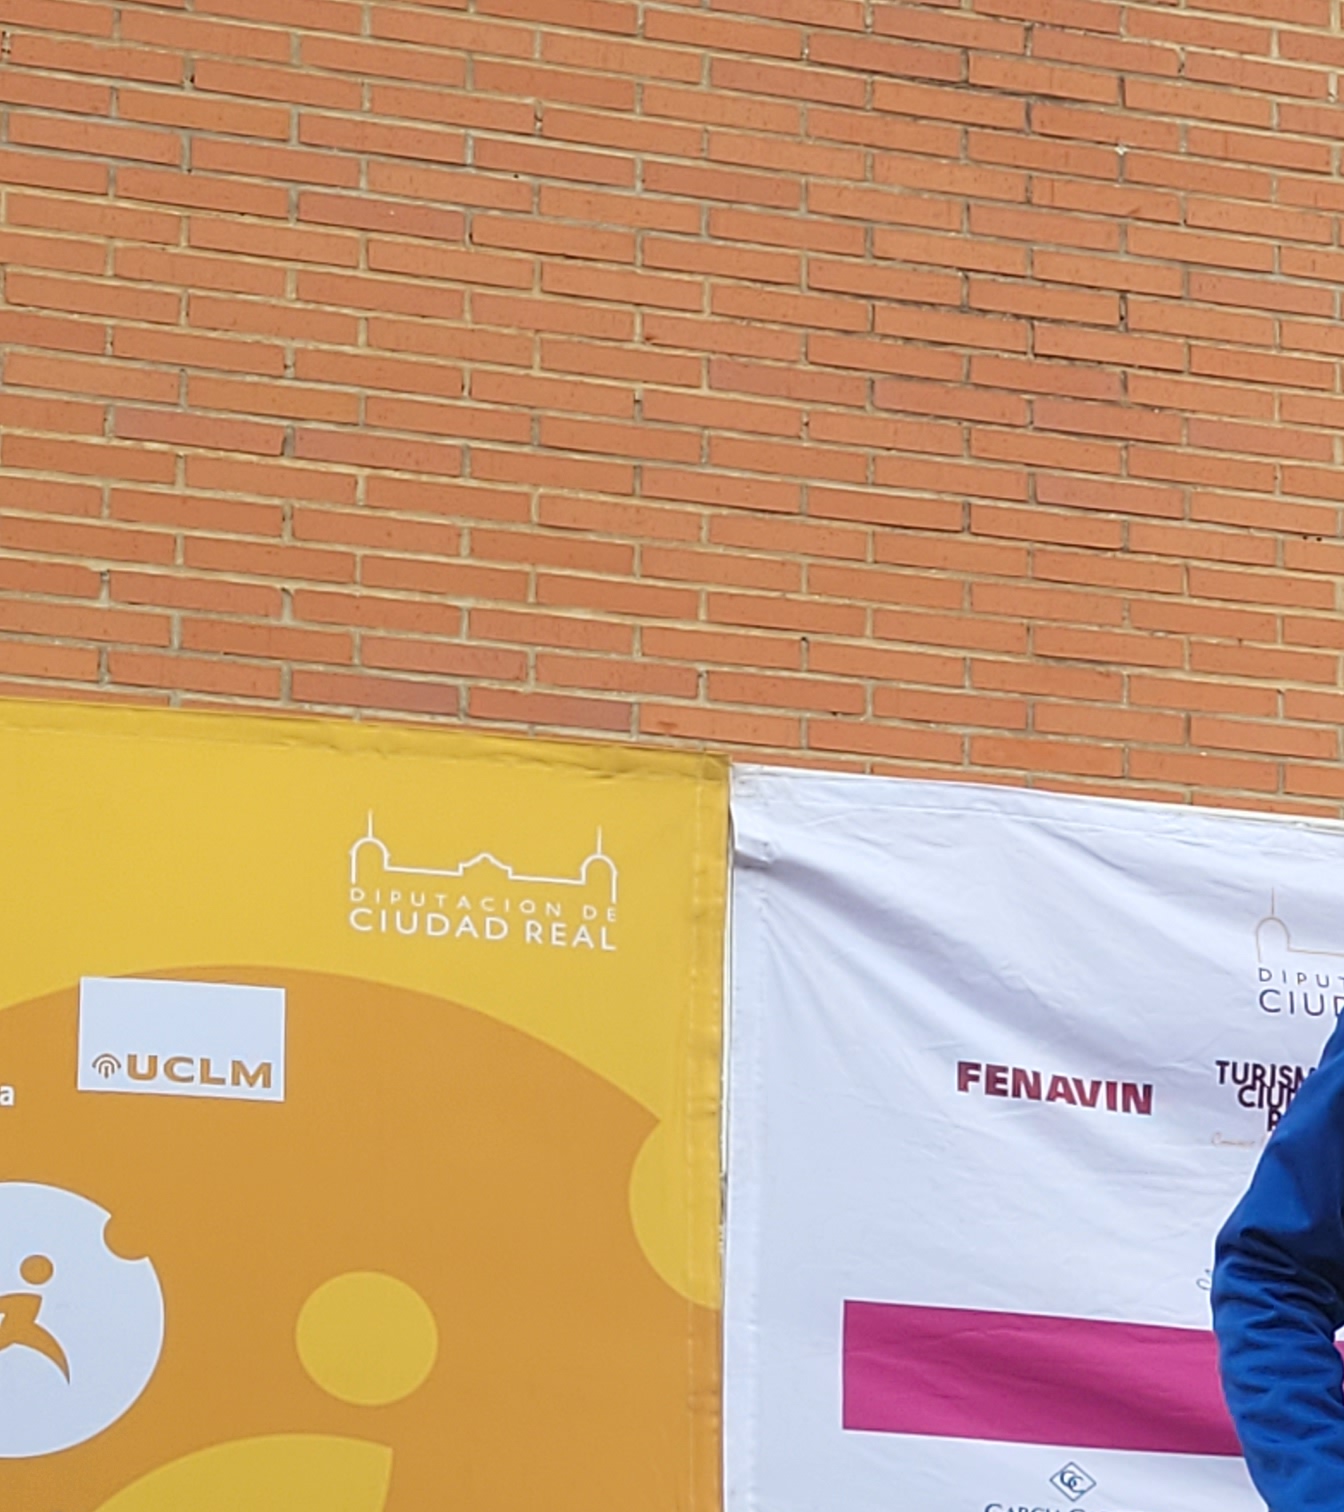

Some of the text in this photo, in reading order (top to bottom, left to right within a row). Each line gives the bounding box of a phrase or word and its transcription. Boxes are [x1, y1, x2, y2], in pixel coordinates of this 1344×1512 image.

[349, 908, 617, 950] CIUDAD REAL
[583, 905, 617, 921] DE
[127, 1053, 273, 1090] UCLM
[956, 1060, 1154, 1116] FENAVIN
